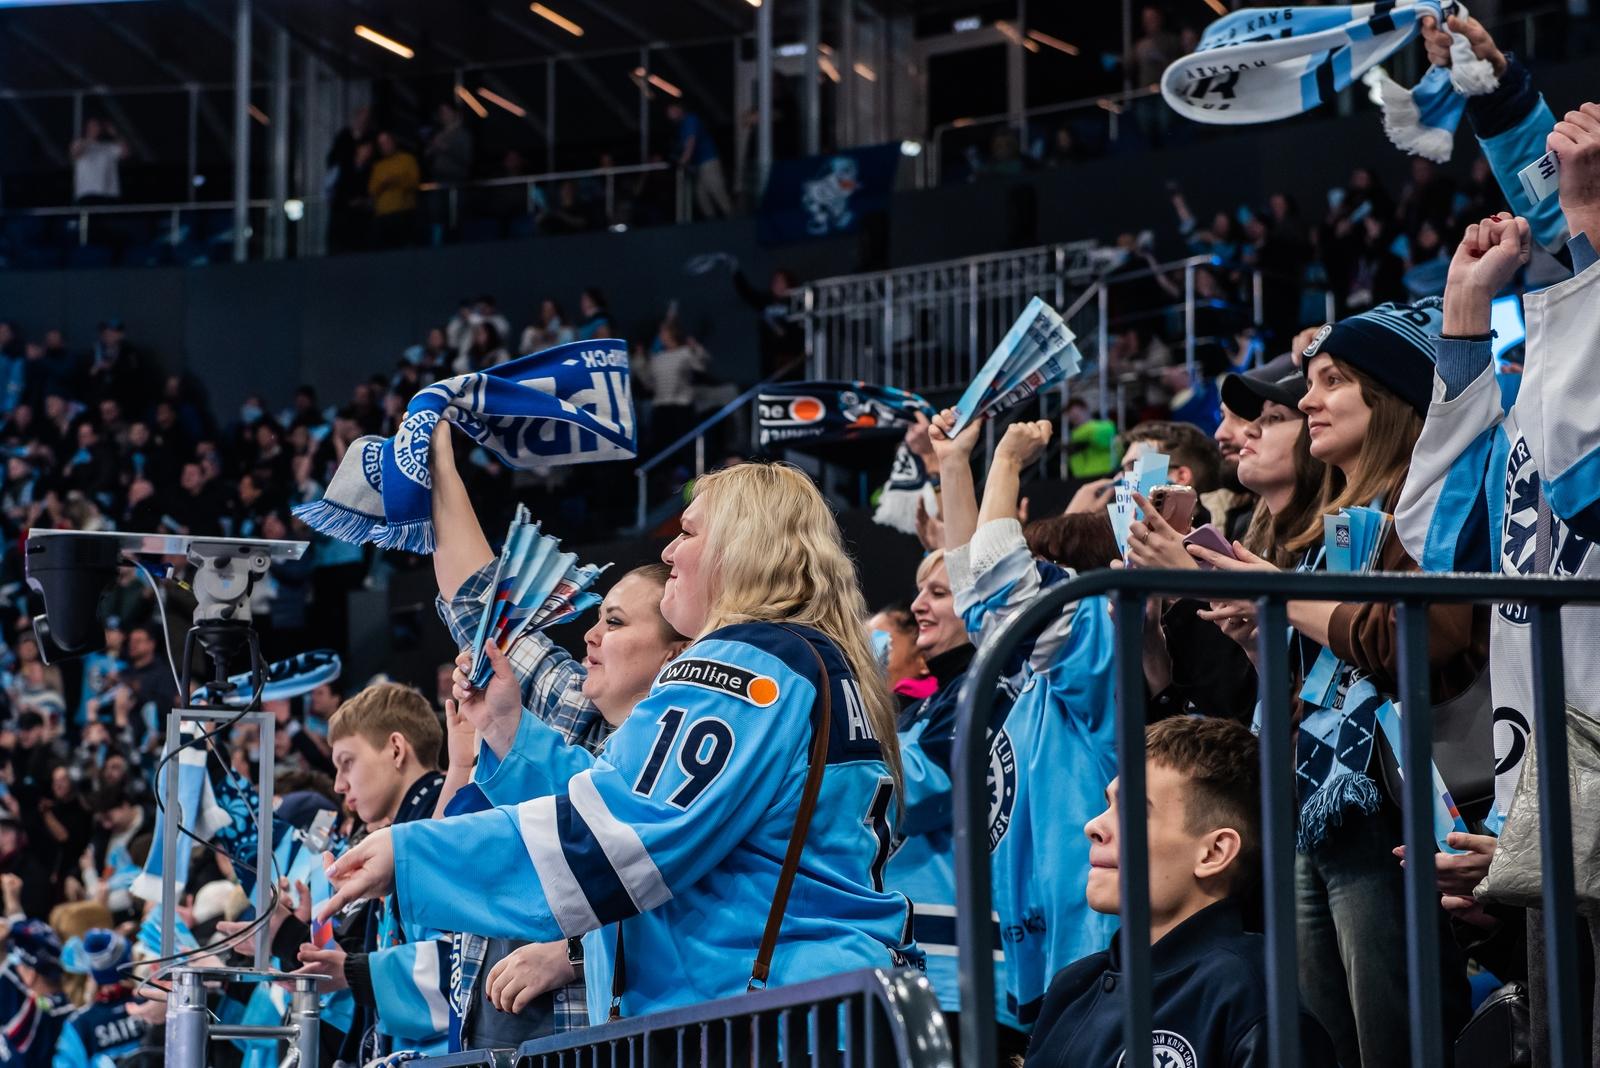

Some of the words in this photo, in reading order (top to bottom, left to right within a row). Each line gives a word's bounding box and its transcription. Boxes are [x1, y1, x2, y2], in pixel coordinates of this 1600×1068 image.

[666, 662, 742, 690] winline
[631, 705, 736, 813] 19
[989, 811, 1009, 849] IRSK
